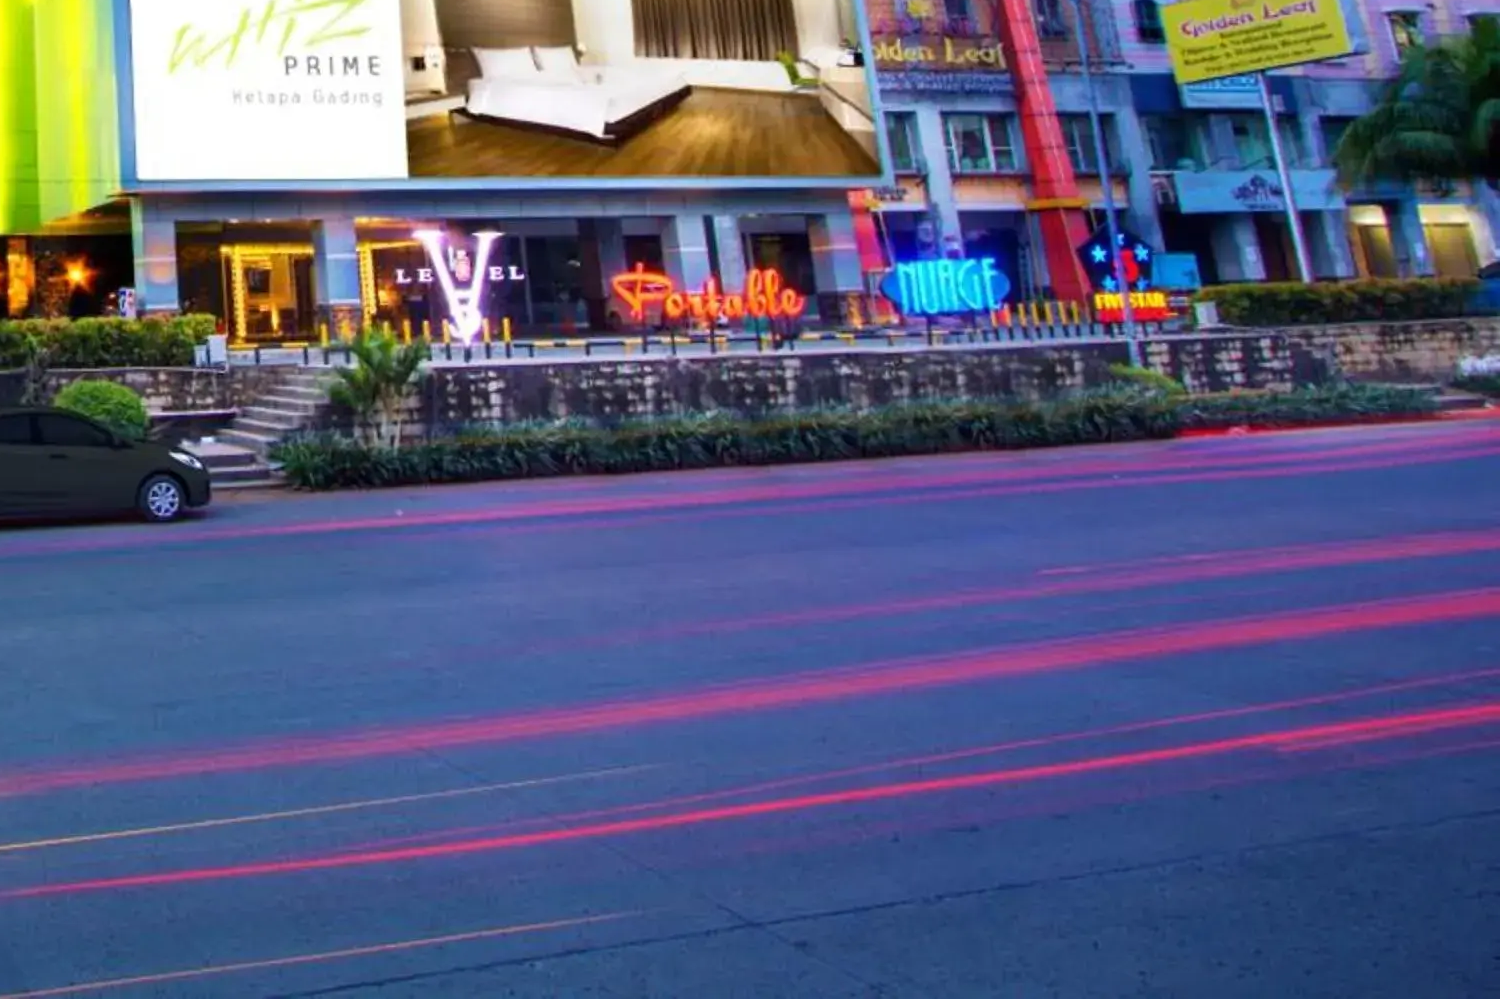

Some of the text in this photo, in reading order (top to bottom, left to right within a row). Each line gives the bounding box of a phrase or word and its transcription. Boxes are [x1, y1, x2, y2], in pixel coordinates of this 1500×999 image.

[1180, 13, 1255, 38] Golden
[284, 55, 382, 77] PRIME
[873, 36, 1008, 69] olden Leaf
[612, 261, 804, 319] Portable
